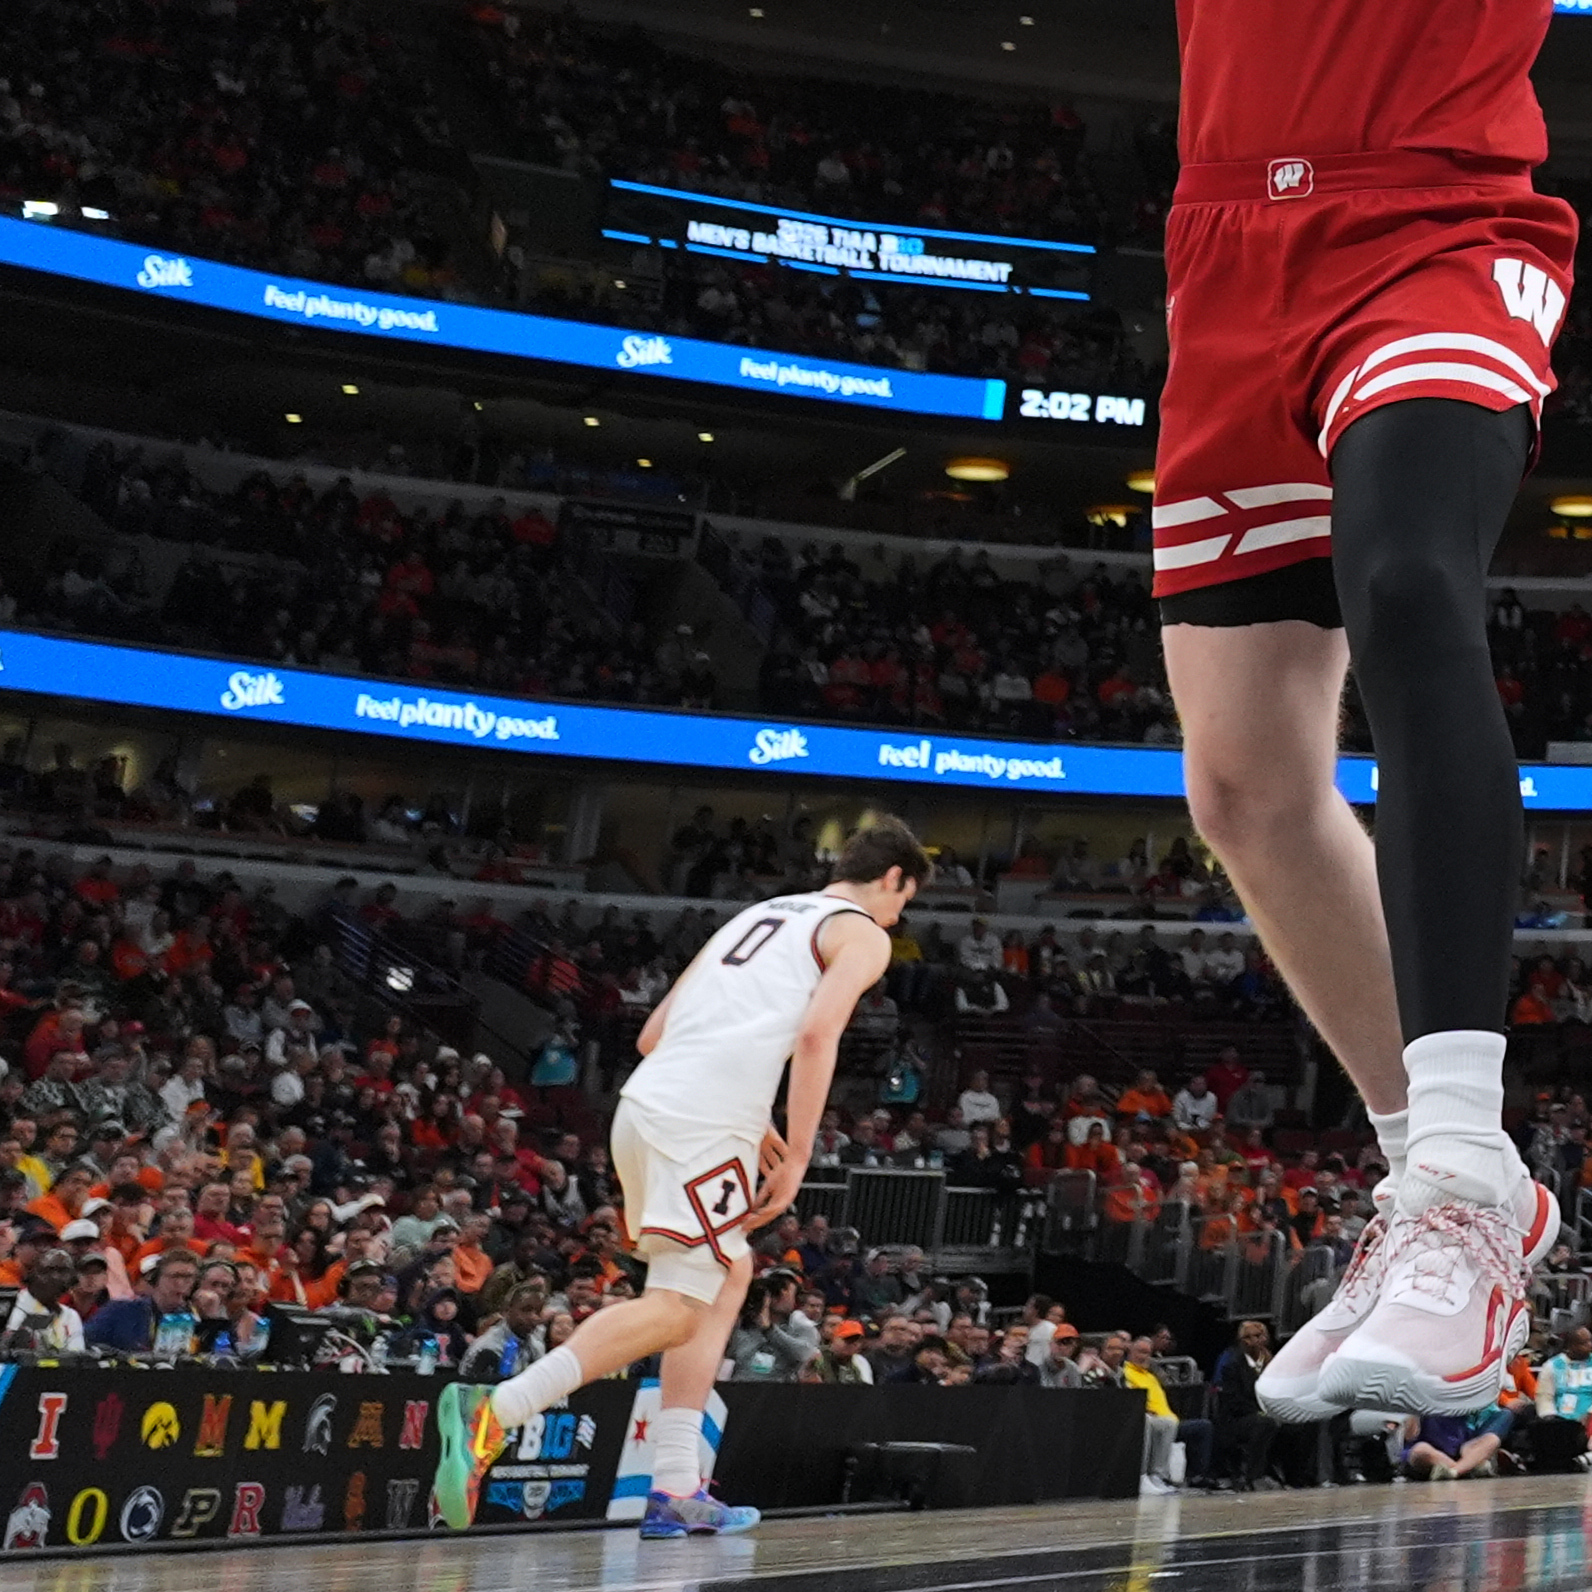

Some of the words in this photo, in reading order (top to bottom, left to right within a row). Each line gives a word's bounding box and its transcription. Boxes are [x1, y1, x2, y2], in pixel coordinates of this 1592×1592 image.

[687, 220, 751, 250] MEN'S
[752, 230, 874, 269] BASKETBALL
[877, 252, 1013, 282] TOURNAMENT
[137, 254, 195, 289] Silk
[264, 285, 305, 312] Feel
[303, 295, 377, 326] planty
[375, 308, 438, 332] good.
[1491, 257, 1566, 348] W
[616, 334, 674, 369] Silk
[740, 358, 779, 381] Feel
[777, 365, 841, 393] planty
[839, 376, 892, 398] good.
[1020, 389, 1091, 421] 2:02
[1095, 397, 1145, 426] PM
[220, 671, 286, 711] Silk
[355, 694, 401, 721] Feel
[399, 698, 495, 738] planty
[493, 716, 559, 740] good.
[748, 728, 811, 766] Silk
[878, 740, 931, 768] Feel
[934, 749, 1006, 779] planty
[1004, 757, 1066, 780] good.
[721, 918, 786, 967] 0
